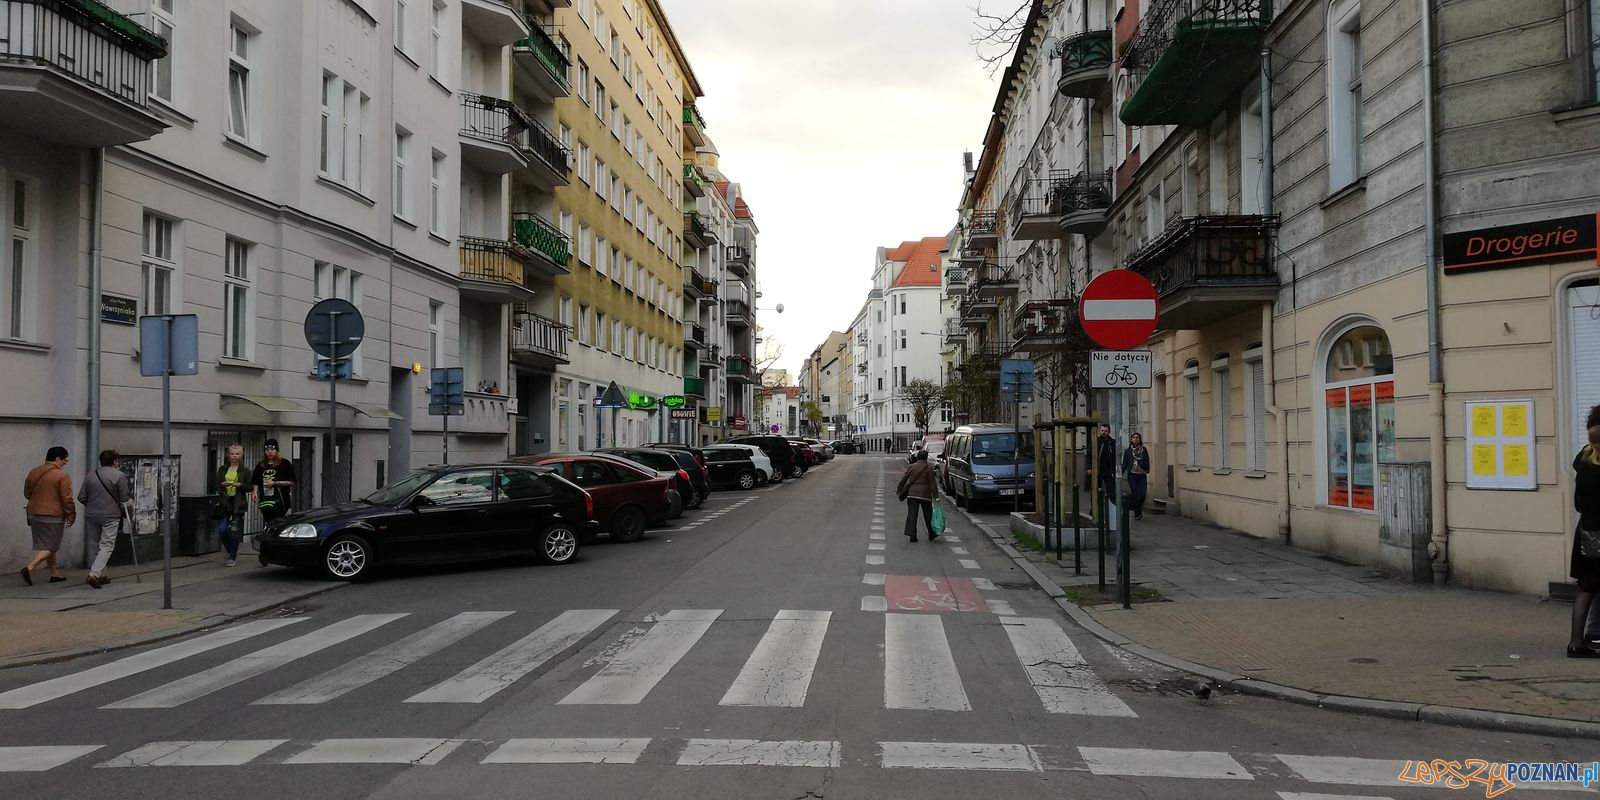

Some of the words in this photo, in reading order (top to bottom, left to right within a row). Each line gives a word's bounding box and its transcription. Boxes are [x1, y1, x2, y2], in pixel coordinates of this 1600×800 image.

[1466, 226, 1578, 256] Drogerie
[1093, 353, 1109, 361] Nie
[1114, 353, 1150, 363] dotyczy
